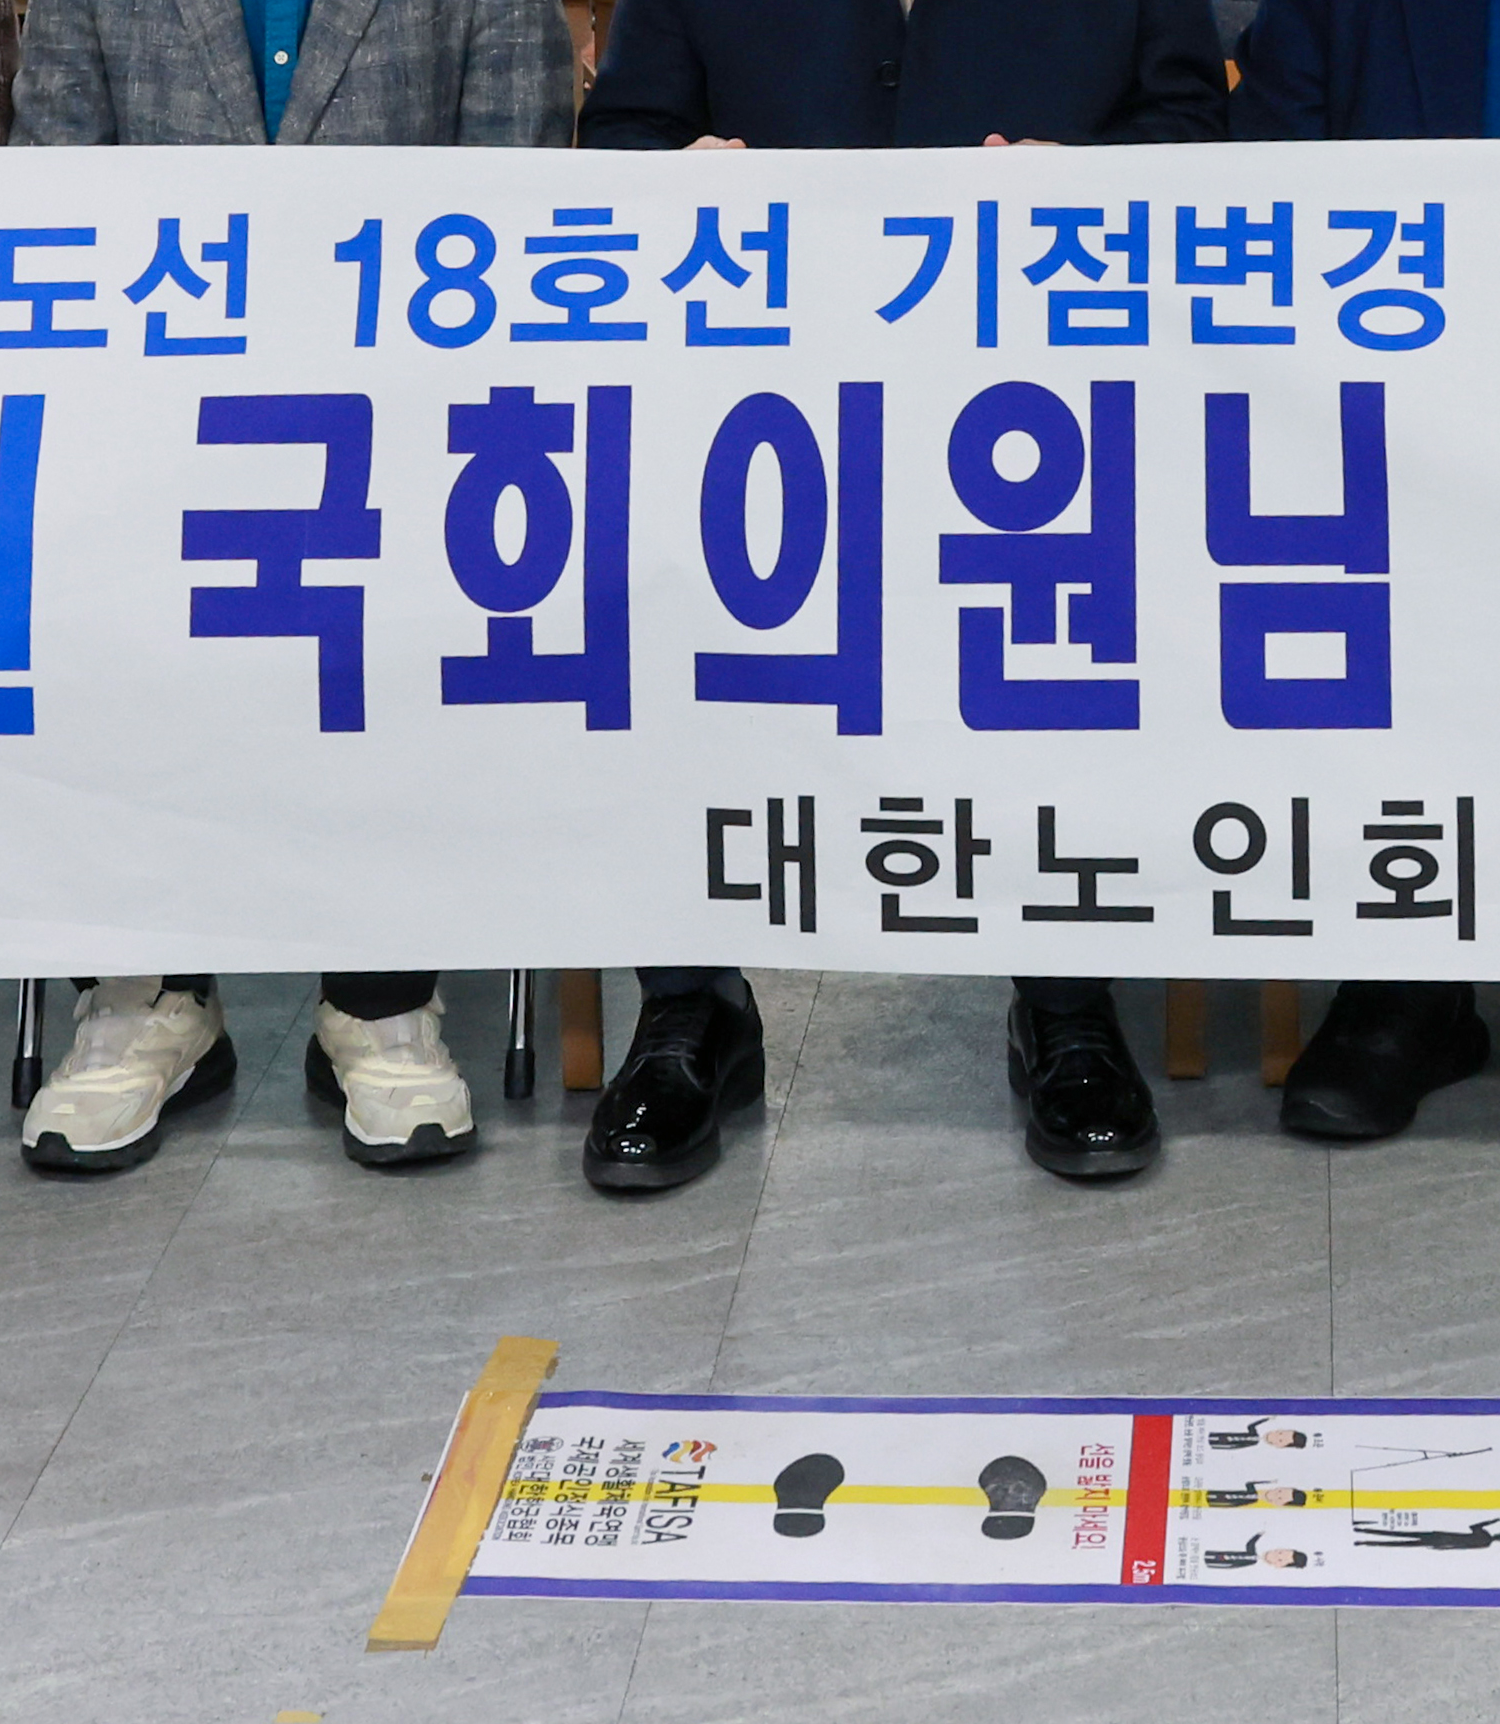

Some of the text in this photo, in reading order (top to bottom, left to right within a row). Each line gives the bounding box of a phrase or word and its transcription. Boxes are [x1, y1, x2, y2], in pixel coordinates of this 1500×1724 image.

[335, 202, 790, 349] 18호선
[879, 201, 1446, 352] 기점변경
[182, 381, 1392, 736] 국회의원님
[706, 796, 1475, 941] 대한노인회
[502, 1471, 552, 1542] 대한한궁협회
[541, 1436, 605, 1546] 국제공인정식종목
[584, 1439, 646, 1547] 세계생활체육연맹
[640, 1465, 707, 1546] TAFISA
[1071, 1443, 1114, 1551] 선을 밟지 마세요!
